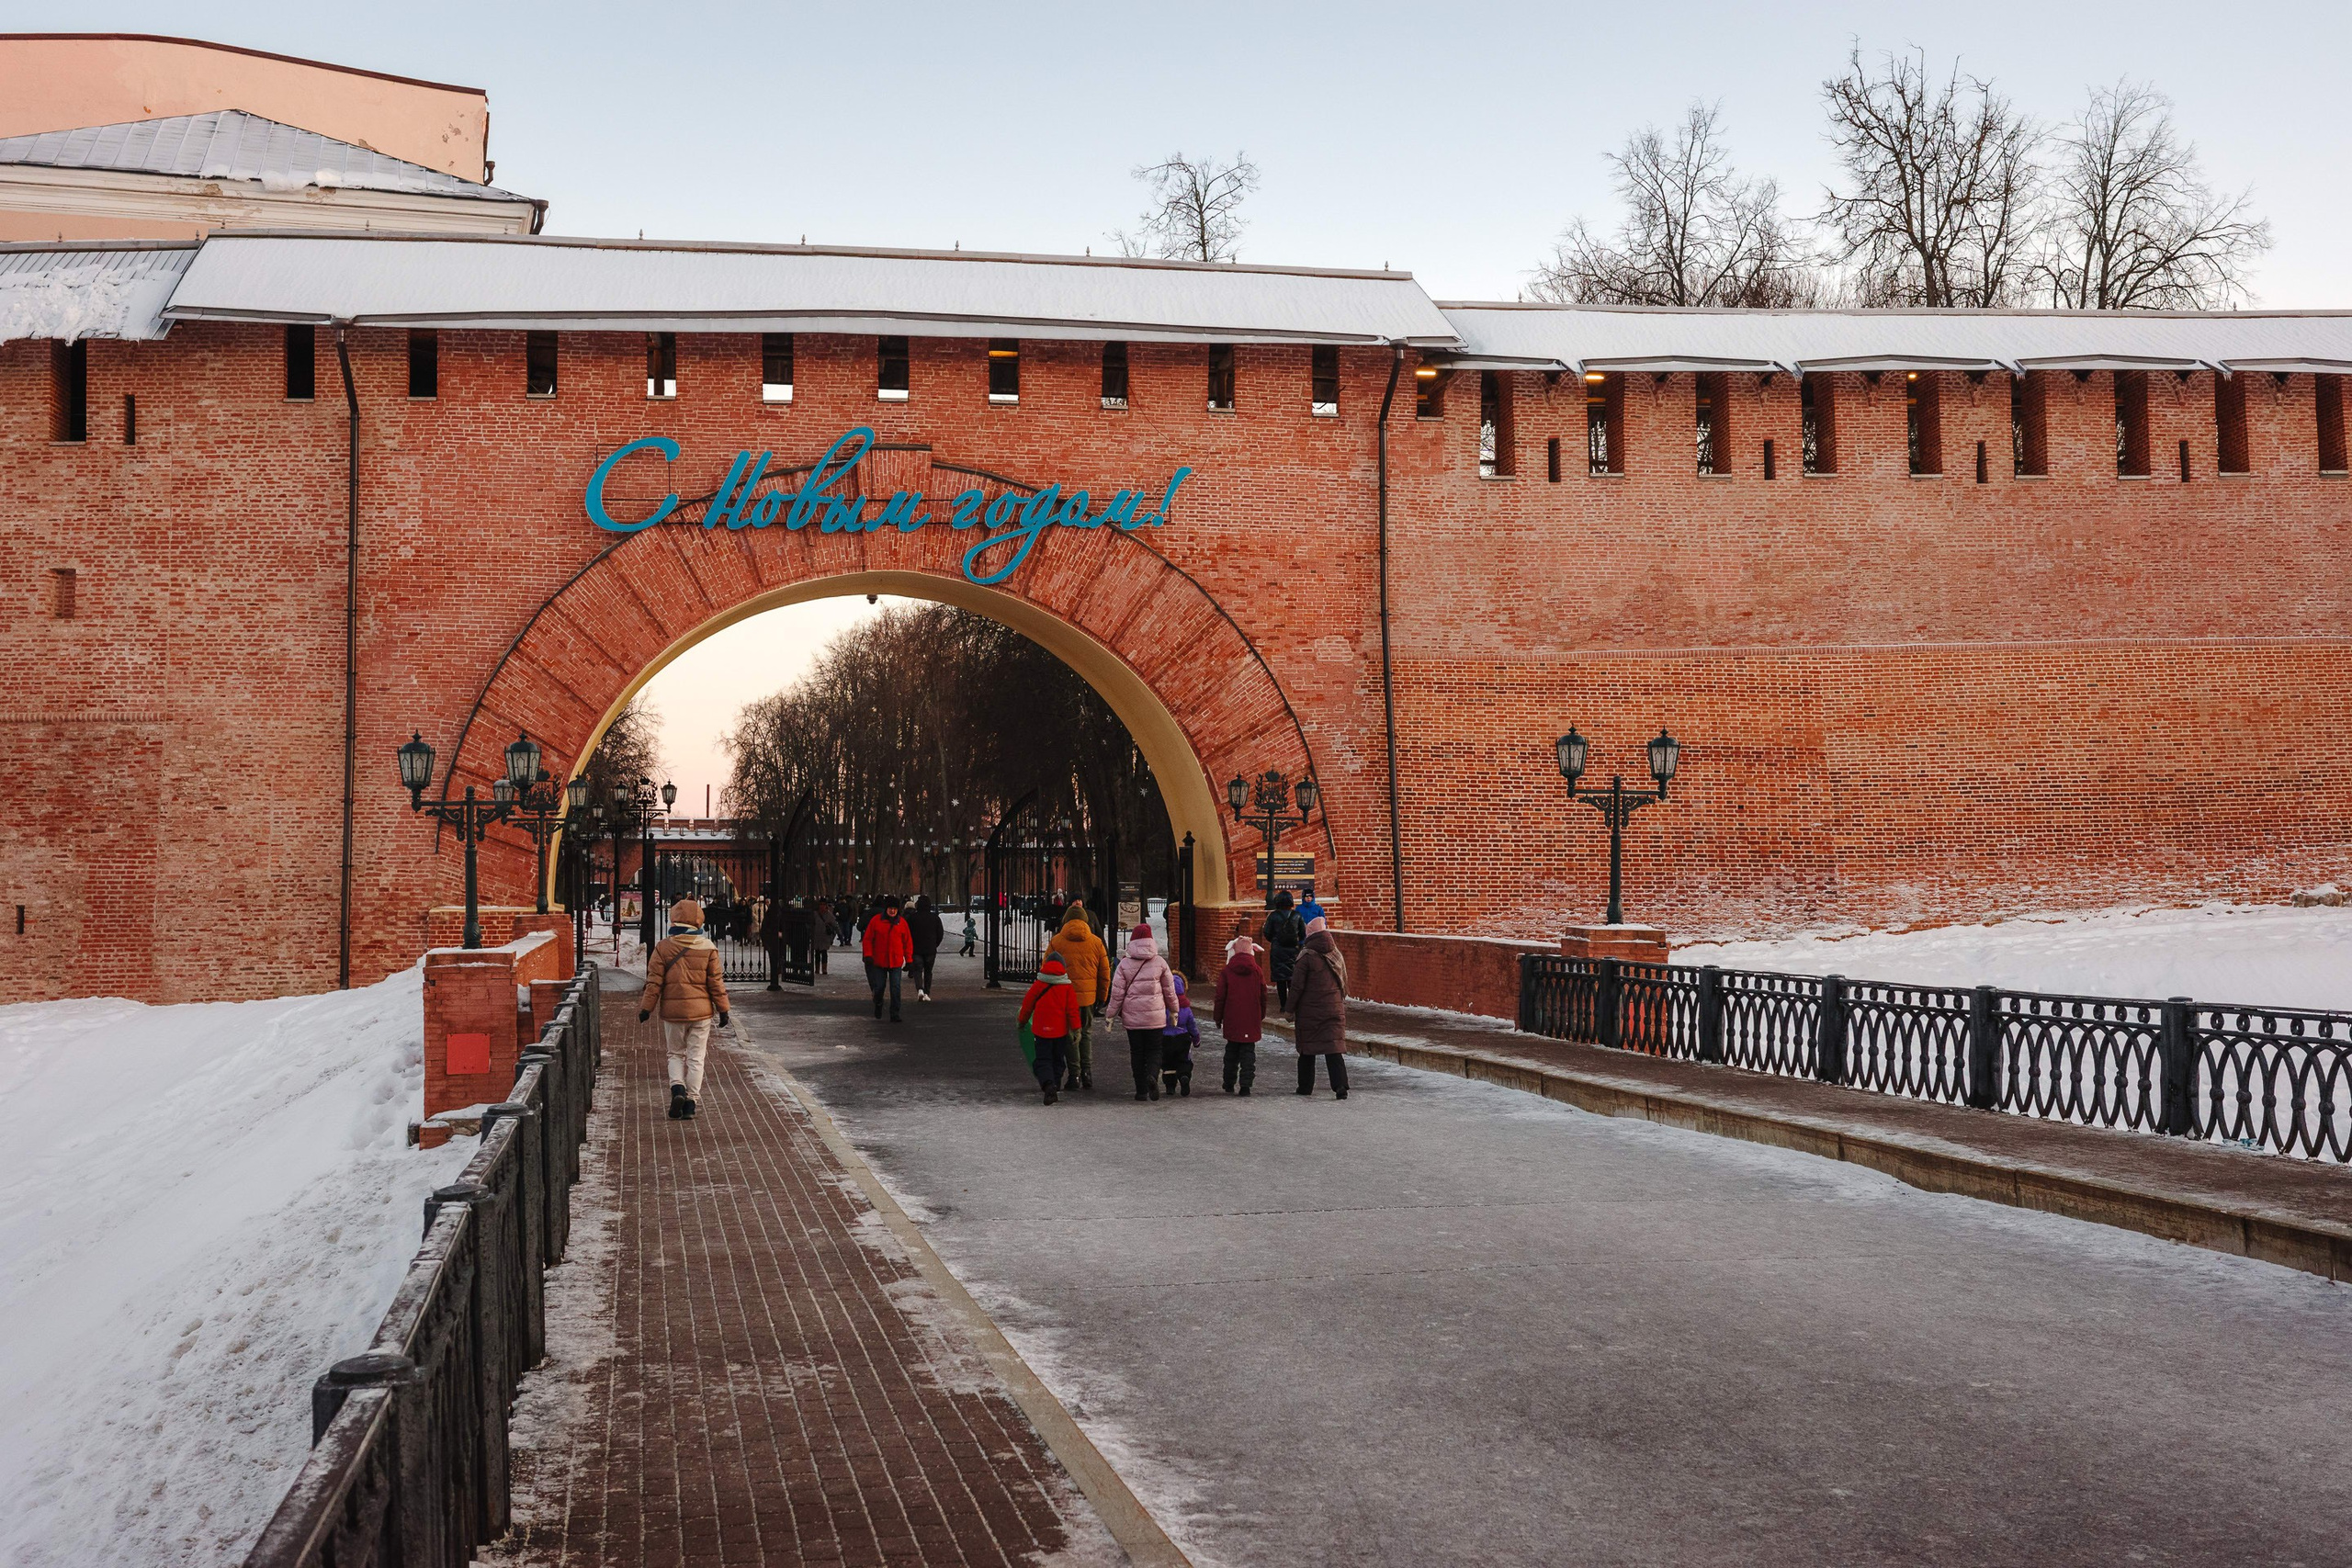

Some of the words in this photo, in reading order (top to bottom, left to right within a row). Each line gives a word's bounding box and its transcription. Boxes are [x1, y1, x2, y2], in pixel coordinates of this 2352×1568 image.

[585, 436, 681, 533] С
[703, 426, 932, 533] Новым
[951, 467, 1192, 585] годом!
